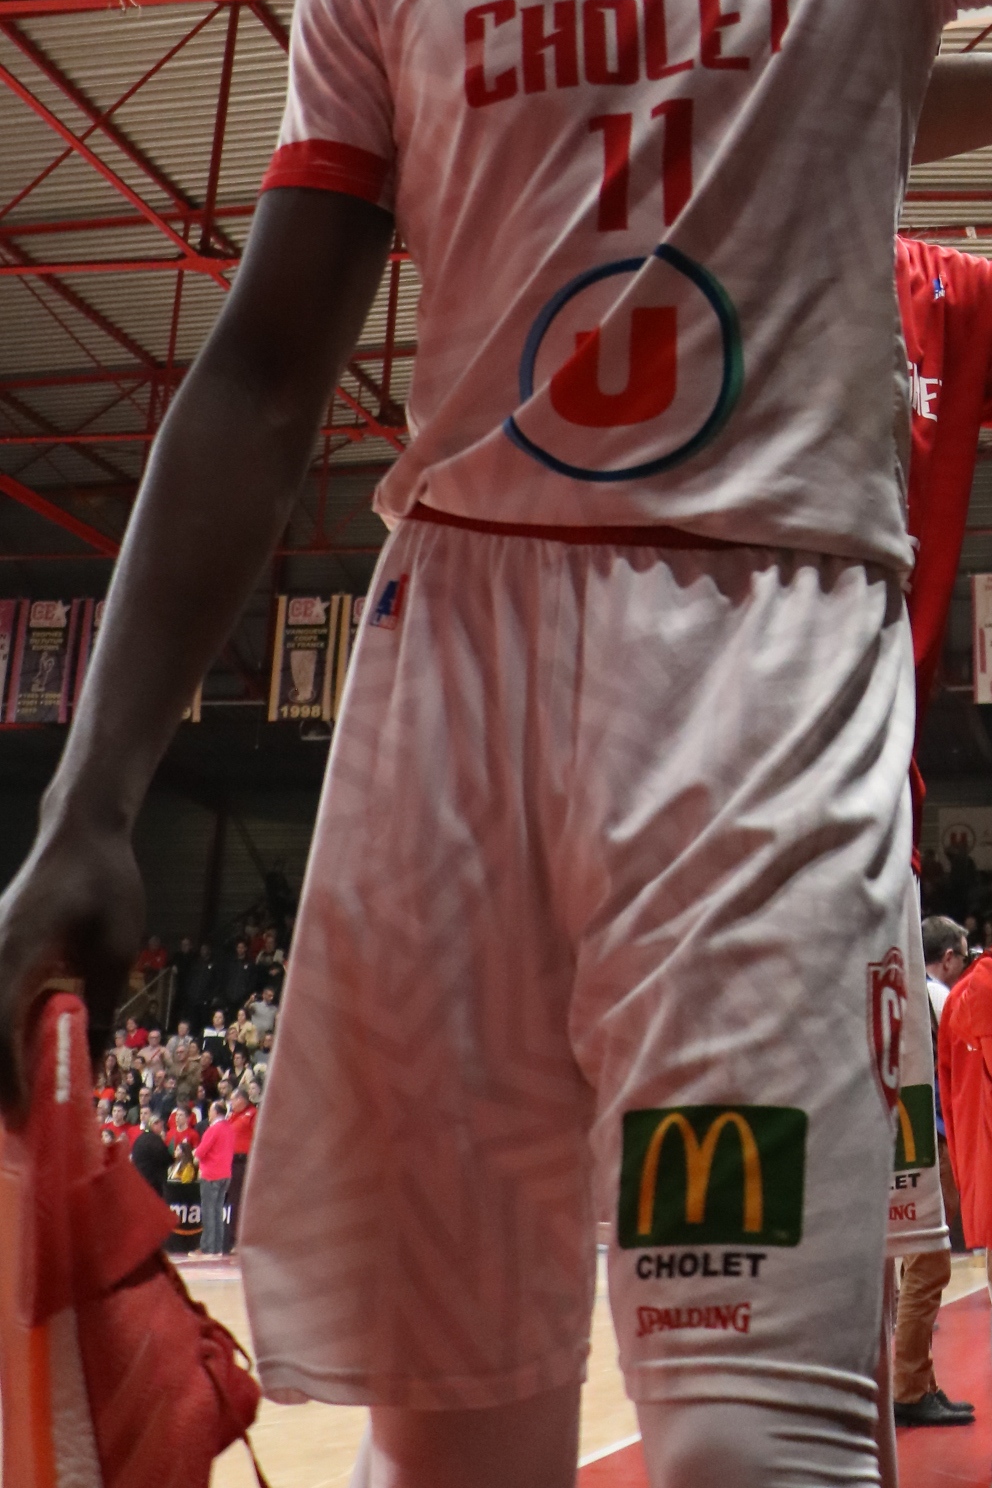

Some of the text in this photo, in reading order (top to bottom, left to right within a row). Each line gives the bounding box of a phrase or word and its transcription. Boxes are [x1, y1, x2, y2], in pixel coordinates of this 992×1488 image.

[589, 98, 694, 232] 11
[280, 704, 321, 719] 1998
[636, 1251, 767, 1280] CHOLET
[636, 1300, 751, 1338] SPALDING
